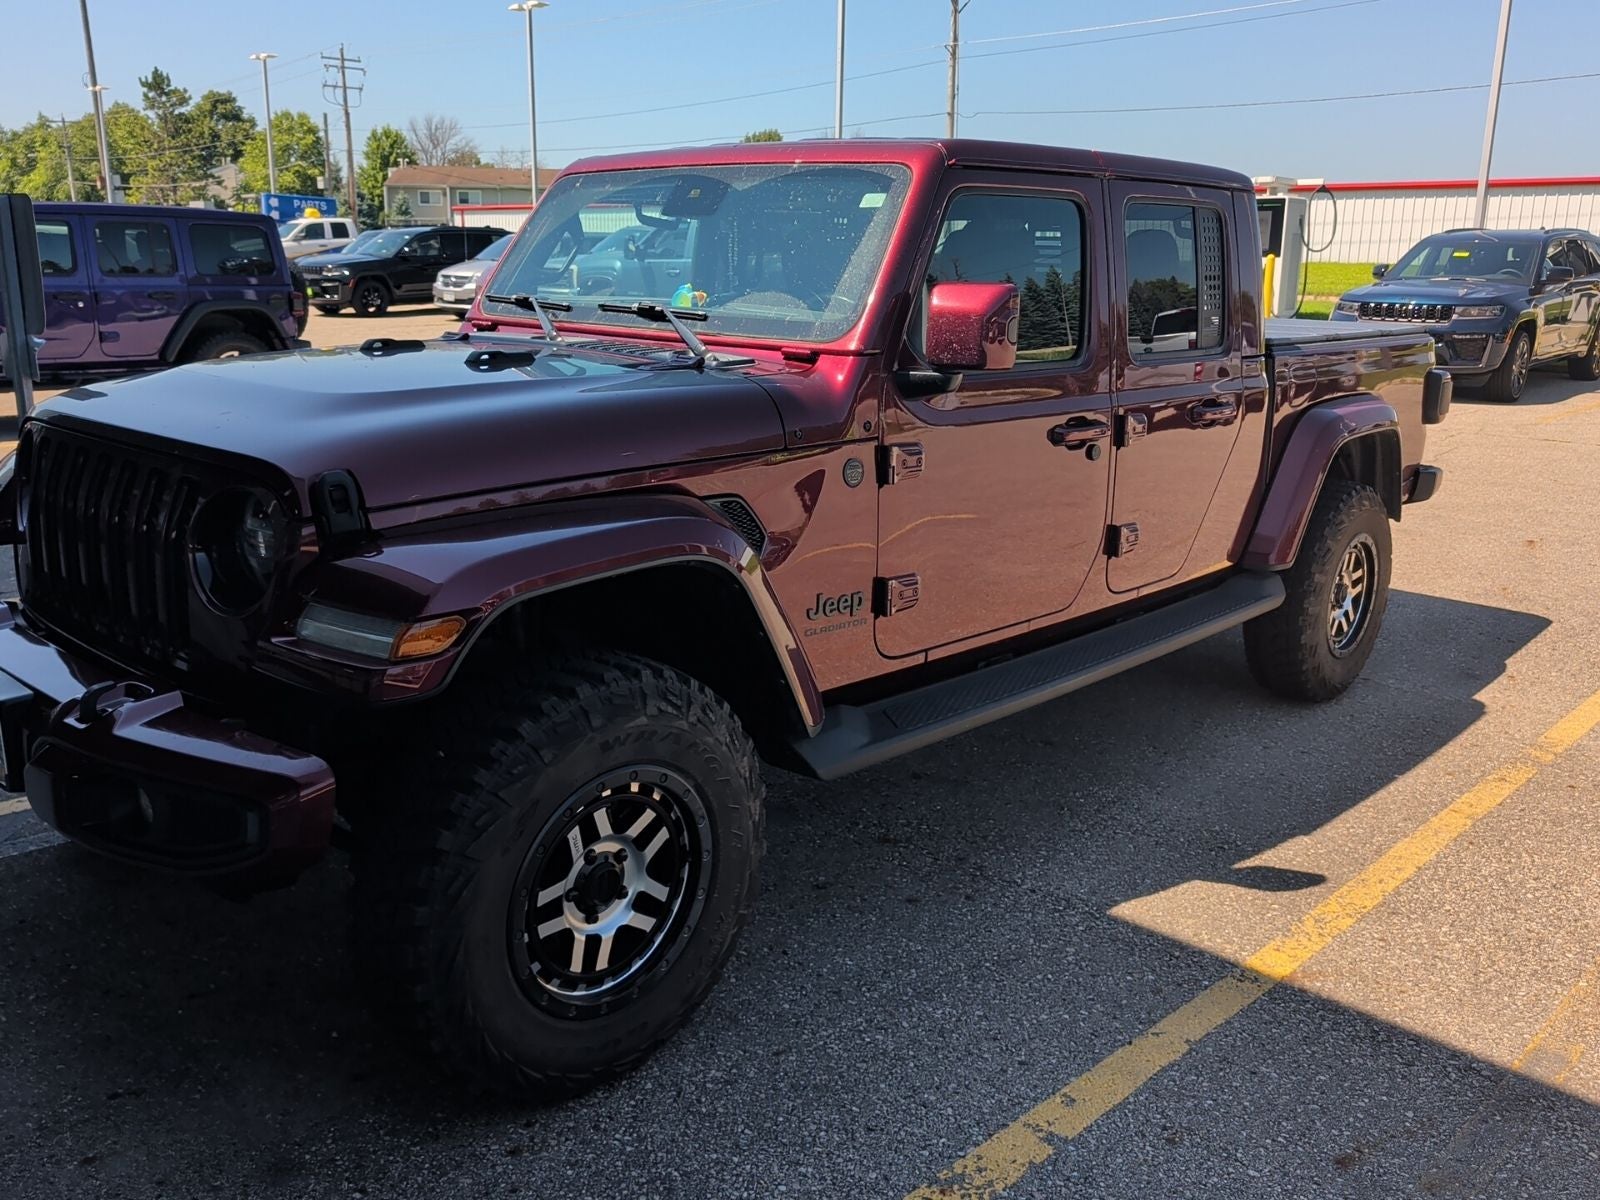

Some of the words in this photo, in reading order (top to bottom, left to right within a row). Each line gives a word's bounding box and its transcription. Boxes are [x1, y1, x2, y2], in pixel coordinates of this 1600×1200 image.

[293, 199, 328, 211] PARTS
[805, 590, 864, 621] Jeep
[804, 618, 868, 637] GLADIATOR
